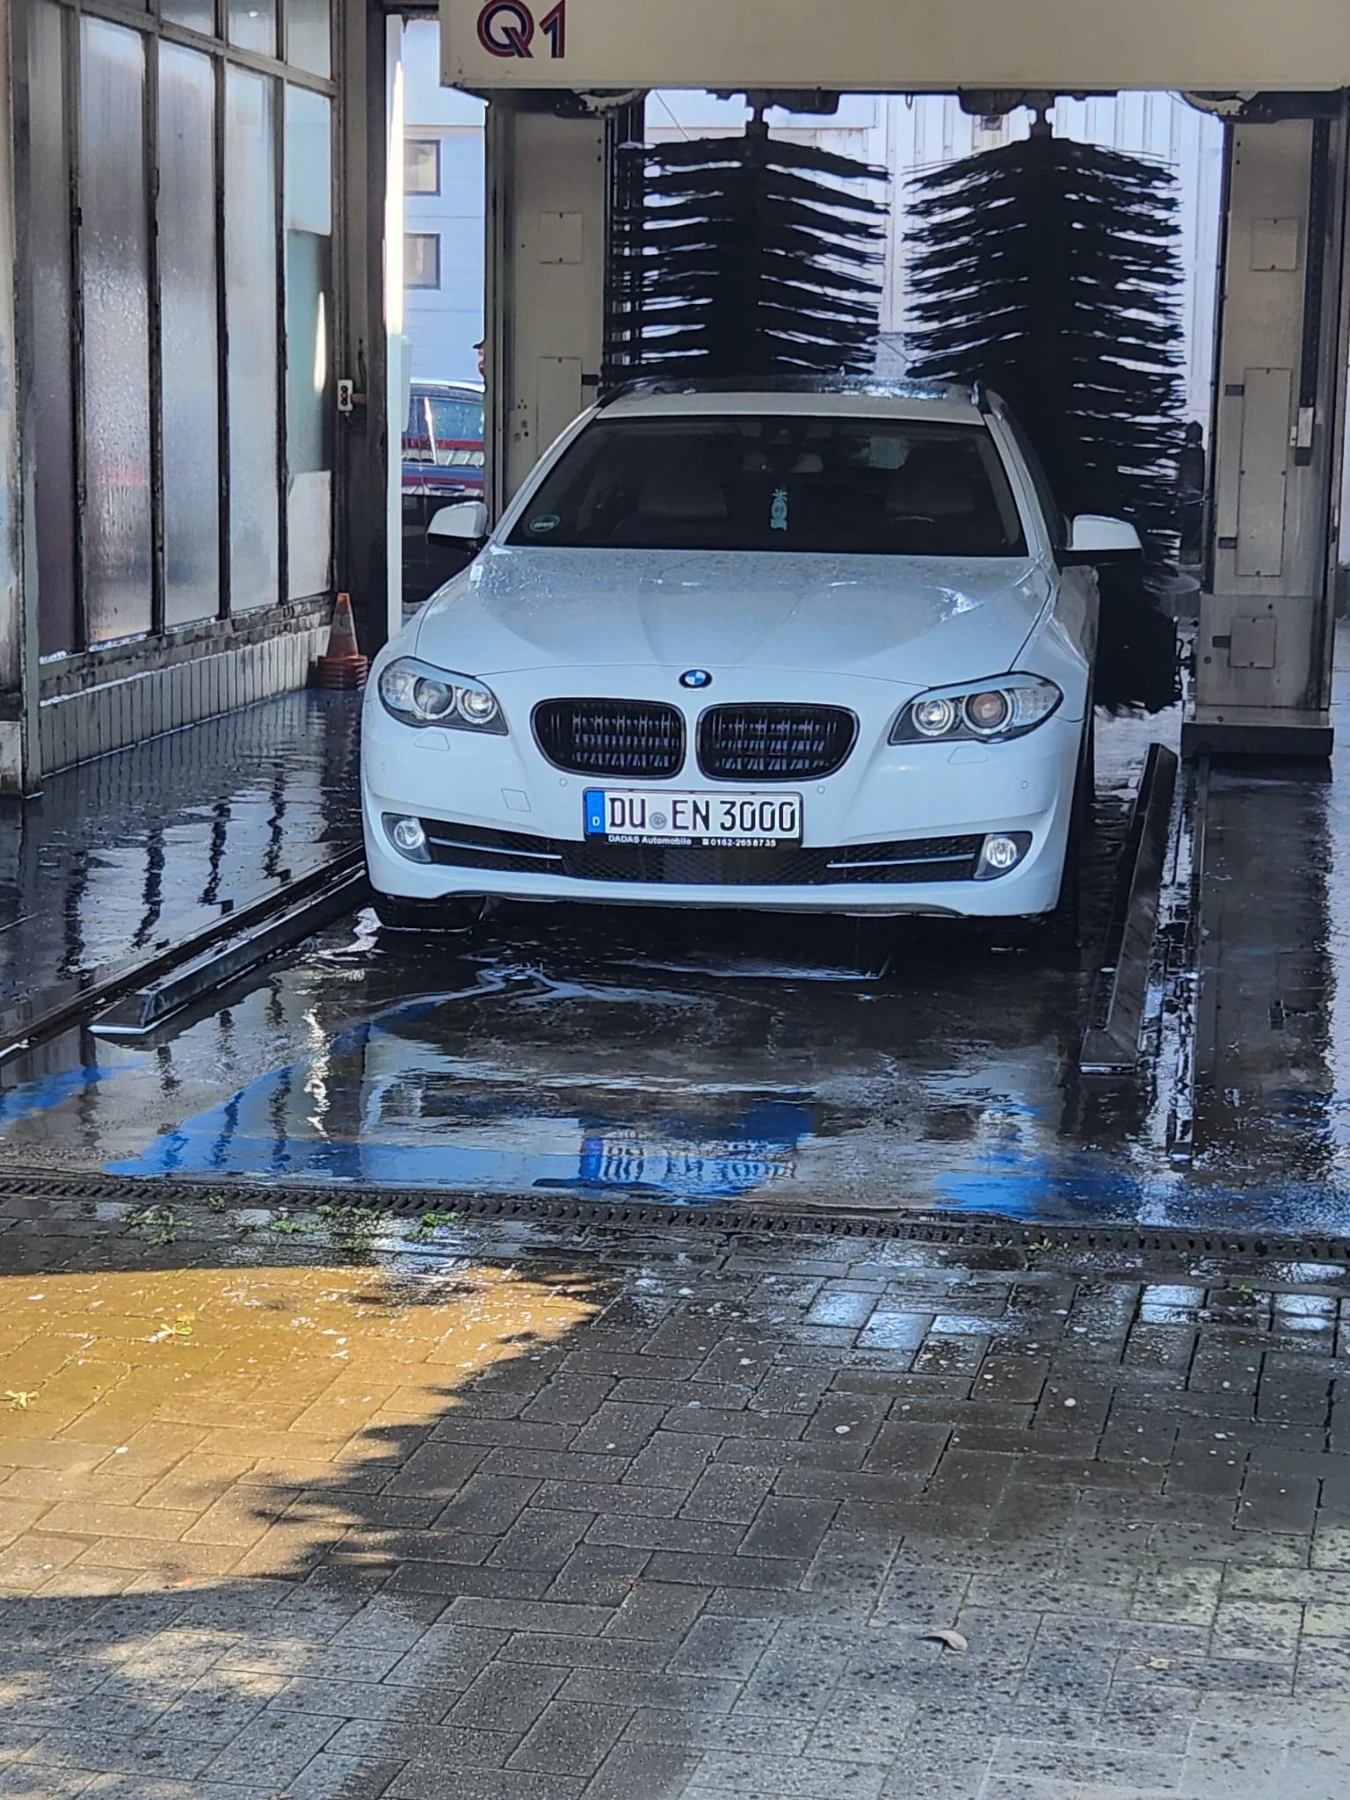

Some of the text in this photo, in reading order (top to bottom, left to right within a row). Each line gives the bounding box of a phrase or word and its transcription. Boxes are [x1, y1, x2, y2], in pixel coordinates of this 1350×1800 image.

[477, 0, 566, 58] Q1
[592, 817, 600, 826] D
[609, 798, 796, 832] DU EN 3000
[608, 835, 640, 843] DADAS
[641, 836, 692, 845] Automobile
